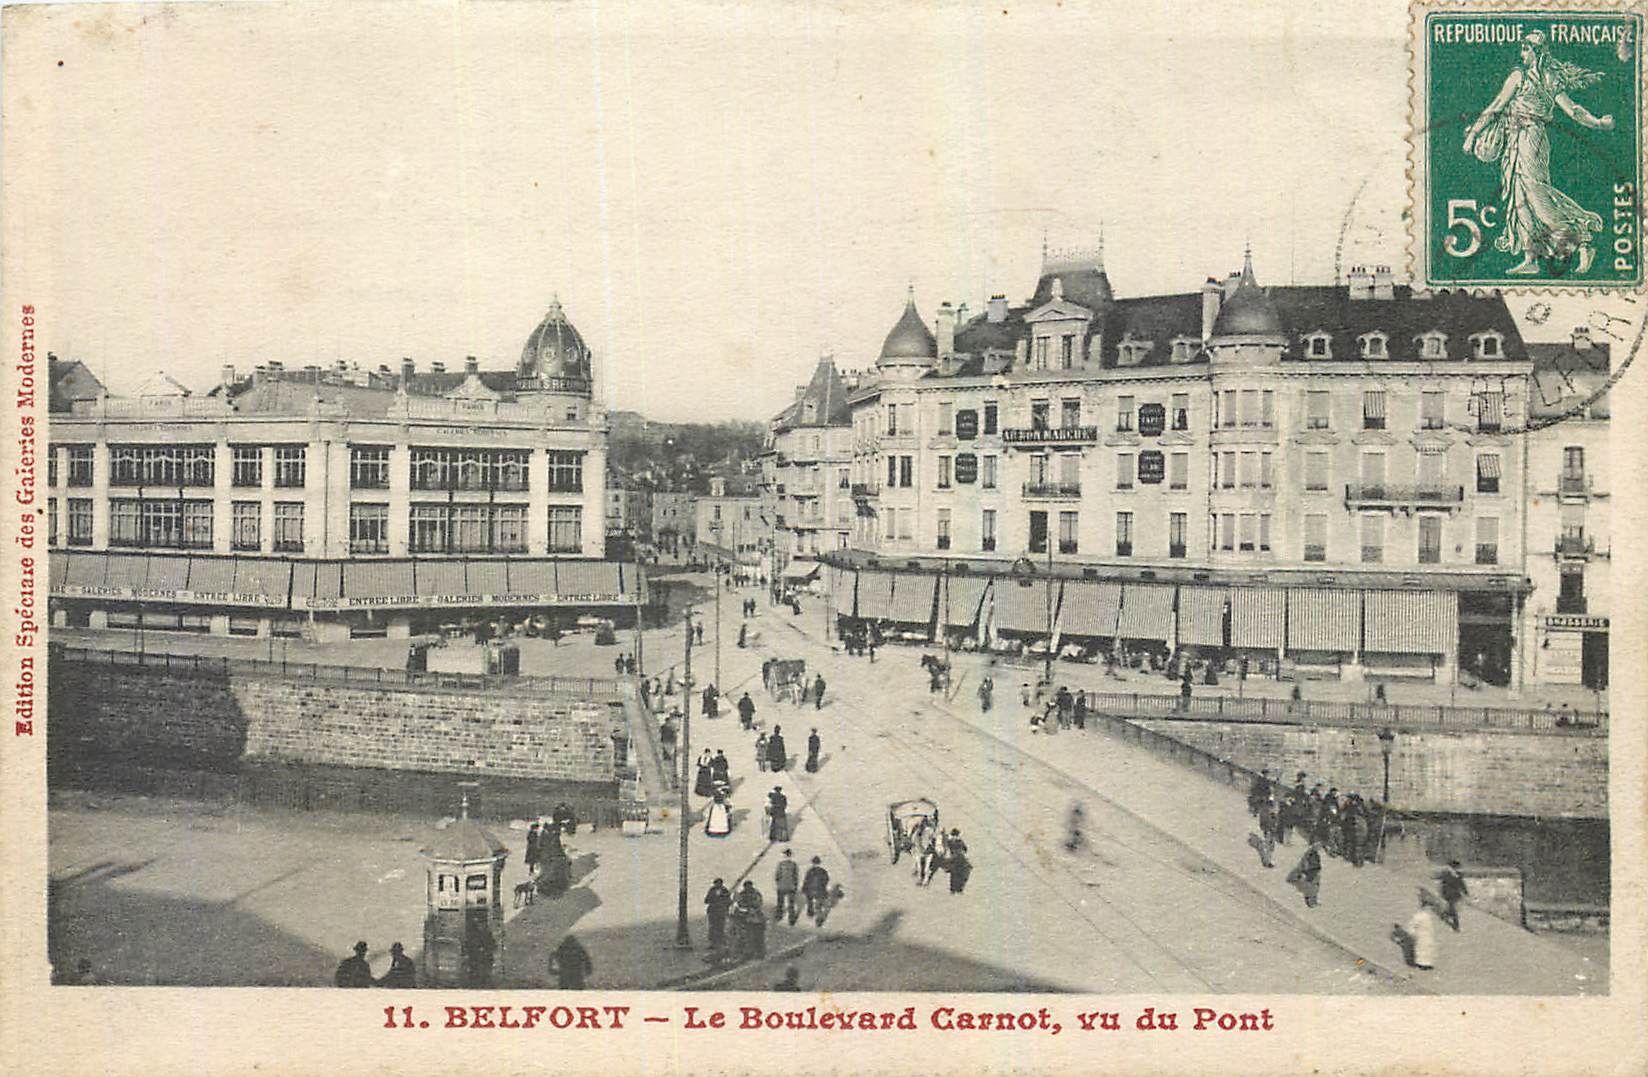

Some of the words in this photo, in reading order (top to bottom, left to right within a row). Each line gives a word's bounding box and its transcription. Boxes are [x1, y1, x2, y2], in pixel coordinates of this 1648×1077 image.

[1434, 23, 1524, 45] REPUBLIQUE
[1551, 24, 1633, 45] FRANÇAISE
[1614, 182, 1634, 270] POSTES
